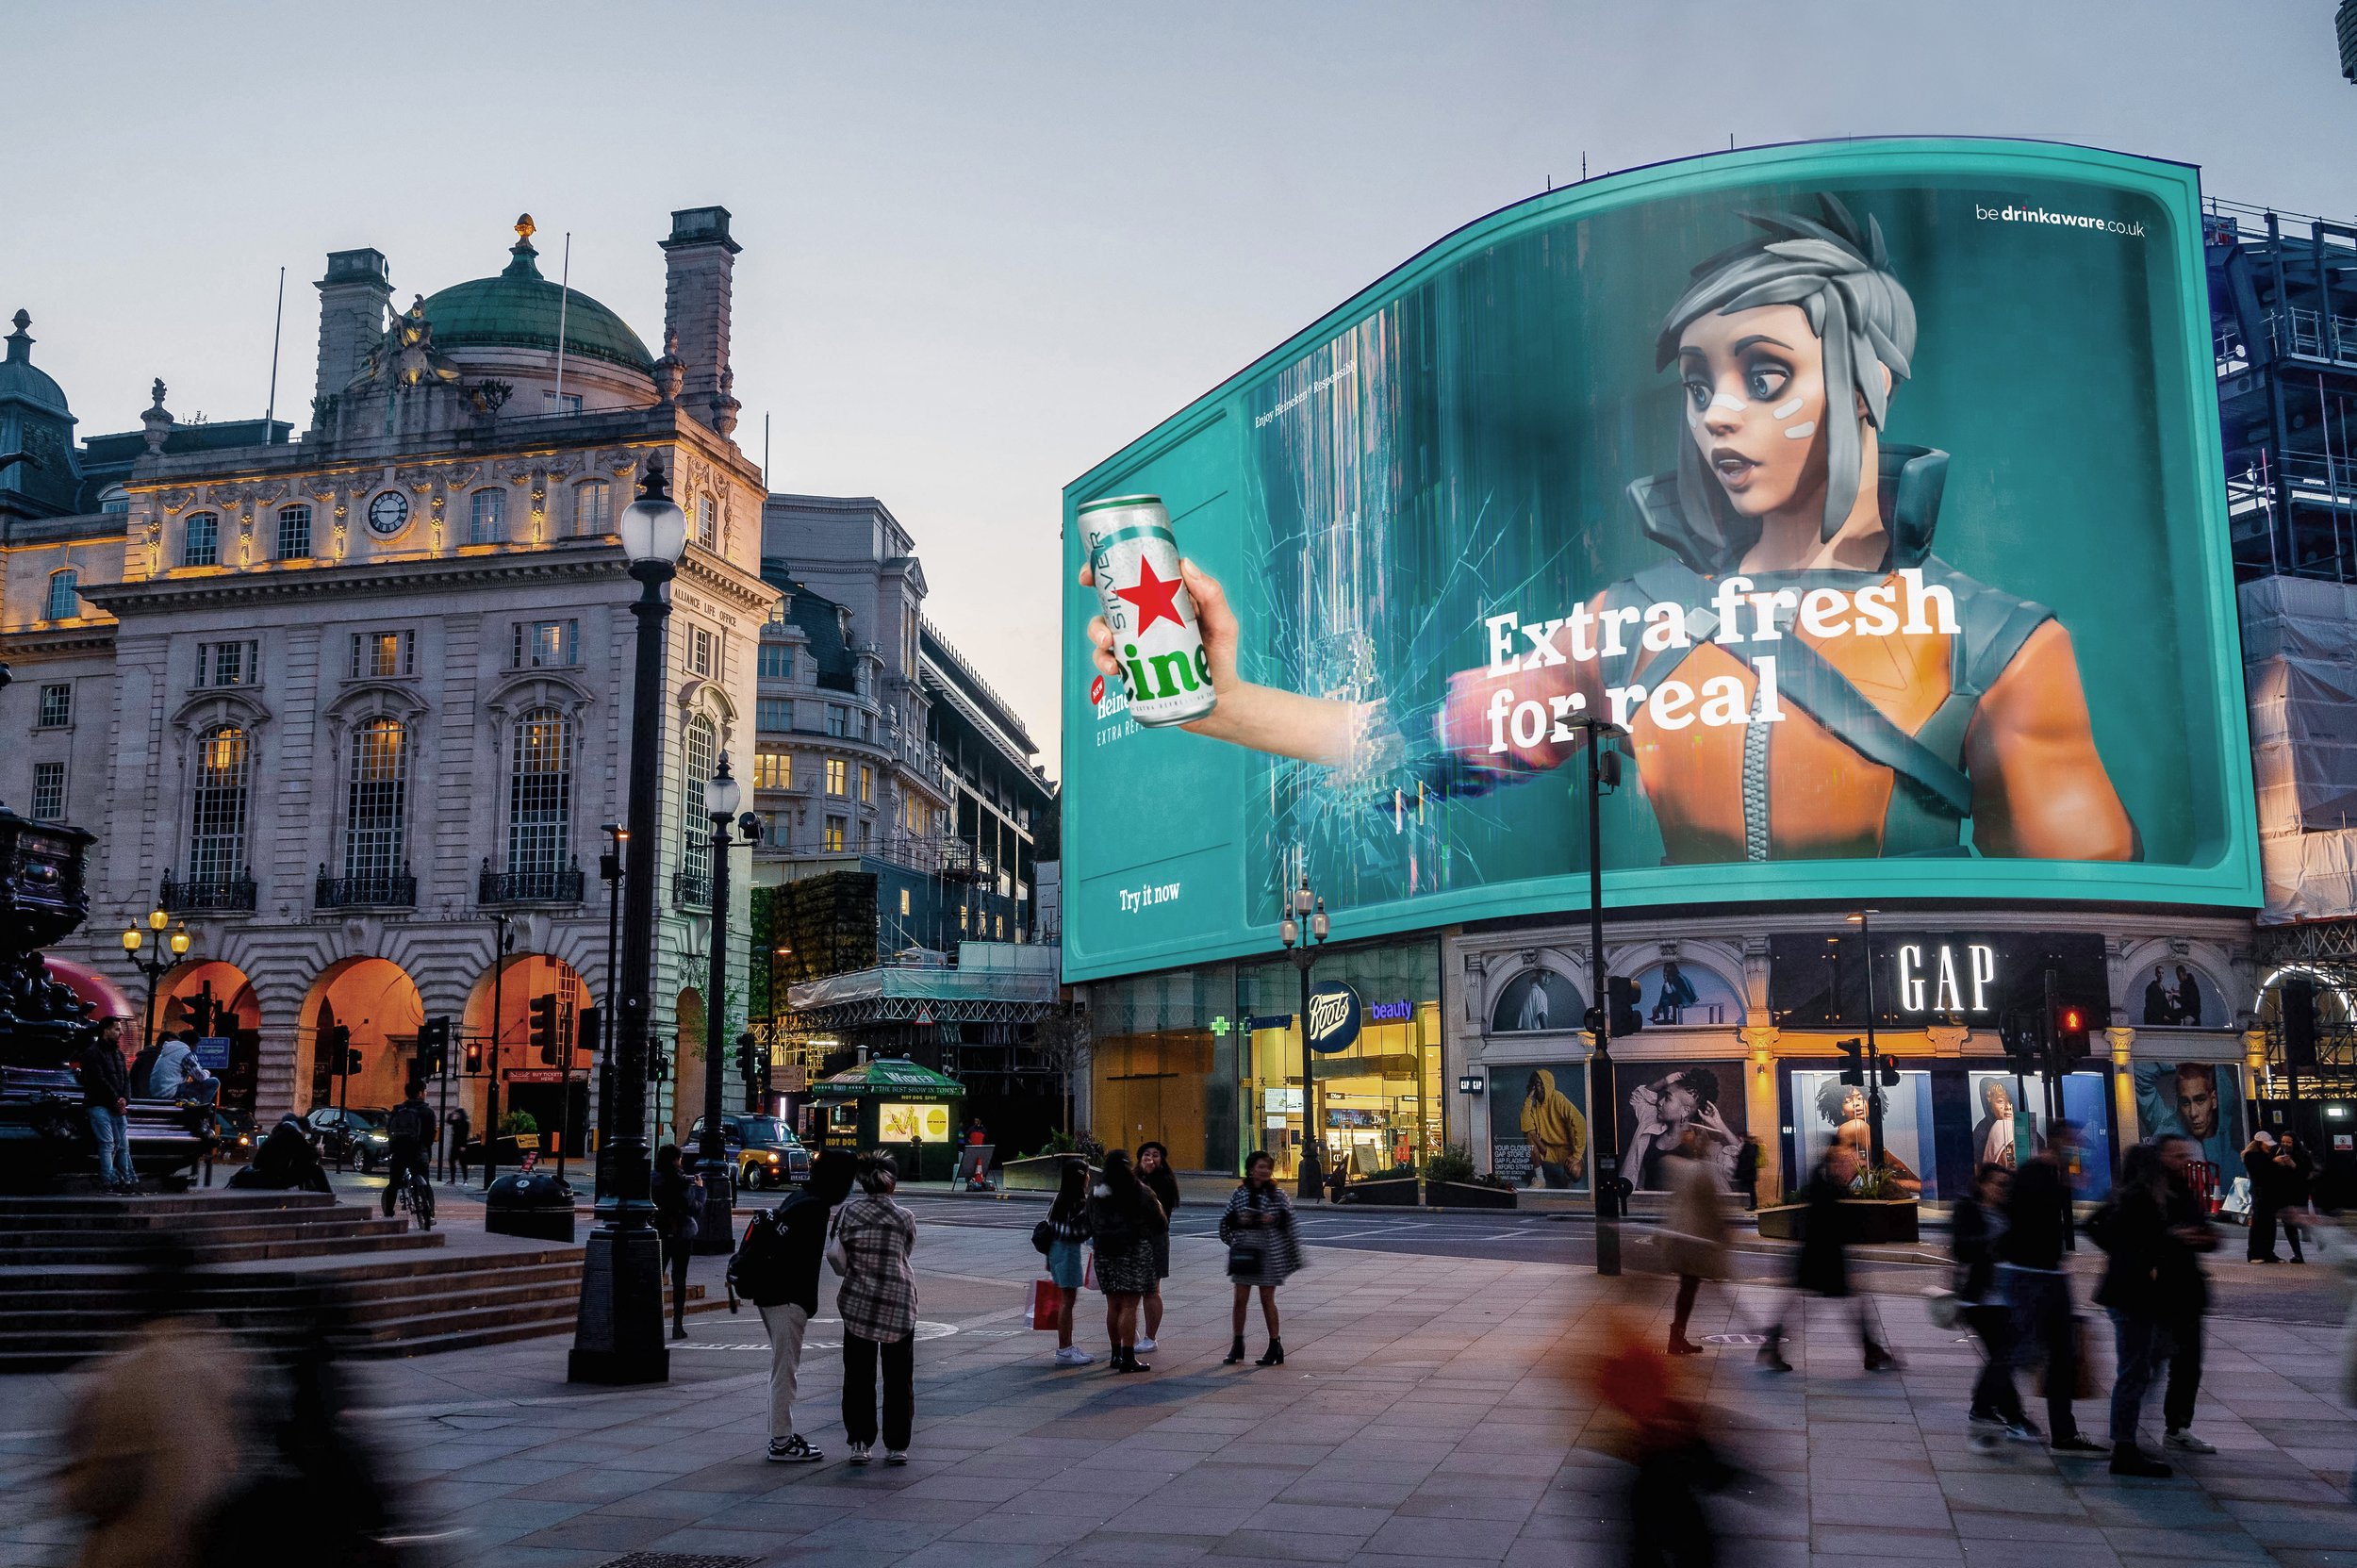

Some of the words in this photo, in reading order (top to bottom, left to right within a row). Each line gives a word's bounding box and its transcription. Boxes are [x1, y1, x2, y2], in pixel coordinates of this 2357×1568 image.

[1255, 409, 1274, 429] Enjoy
[1313, 359, 1358, 394] Responsibly
[1090, 531, 1127, 630] SILVER
[674, 587, 701, 610] ALLIANCE
[704, 602, 717, 618] LIFE
[719, 610, 737, 628] OFFICE
[1485, 601, 1692, 680] Extra
[1709, 568, 1962, 645] fresh
[1092, 680, 1104, 700] NEW
[1486, 687, 1587, 755] for
[1605, 655, 1787, 734] real
[1096, 723, 1122, 748] EXTRA
[1119, 888, 1141, 914] Try
[1143, 883, 1152, 906] it
[1154, 882, 1180, 904] now
[1899, 945, 1994, 1012] GAP
[1309, 990, 1350, 1041] Boots
[1372, 997, 1413, 1020] beauty
[892, 1085, 907, 1094] BEST
[1460, 1081, 1470, 1090] GAP
[1473, 1081, 1482, 1090] GAP
[825, 1138, 840, 1147] HOT
[842, 1138, 857, 1147] DOG
